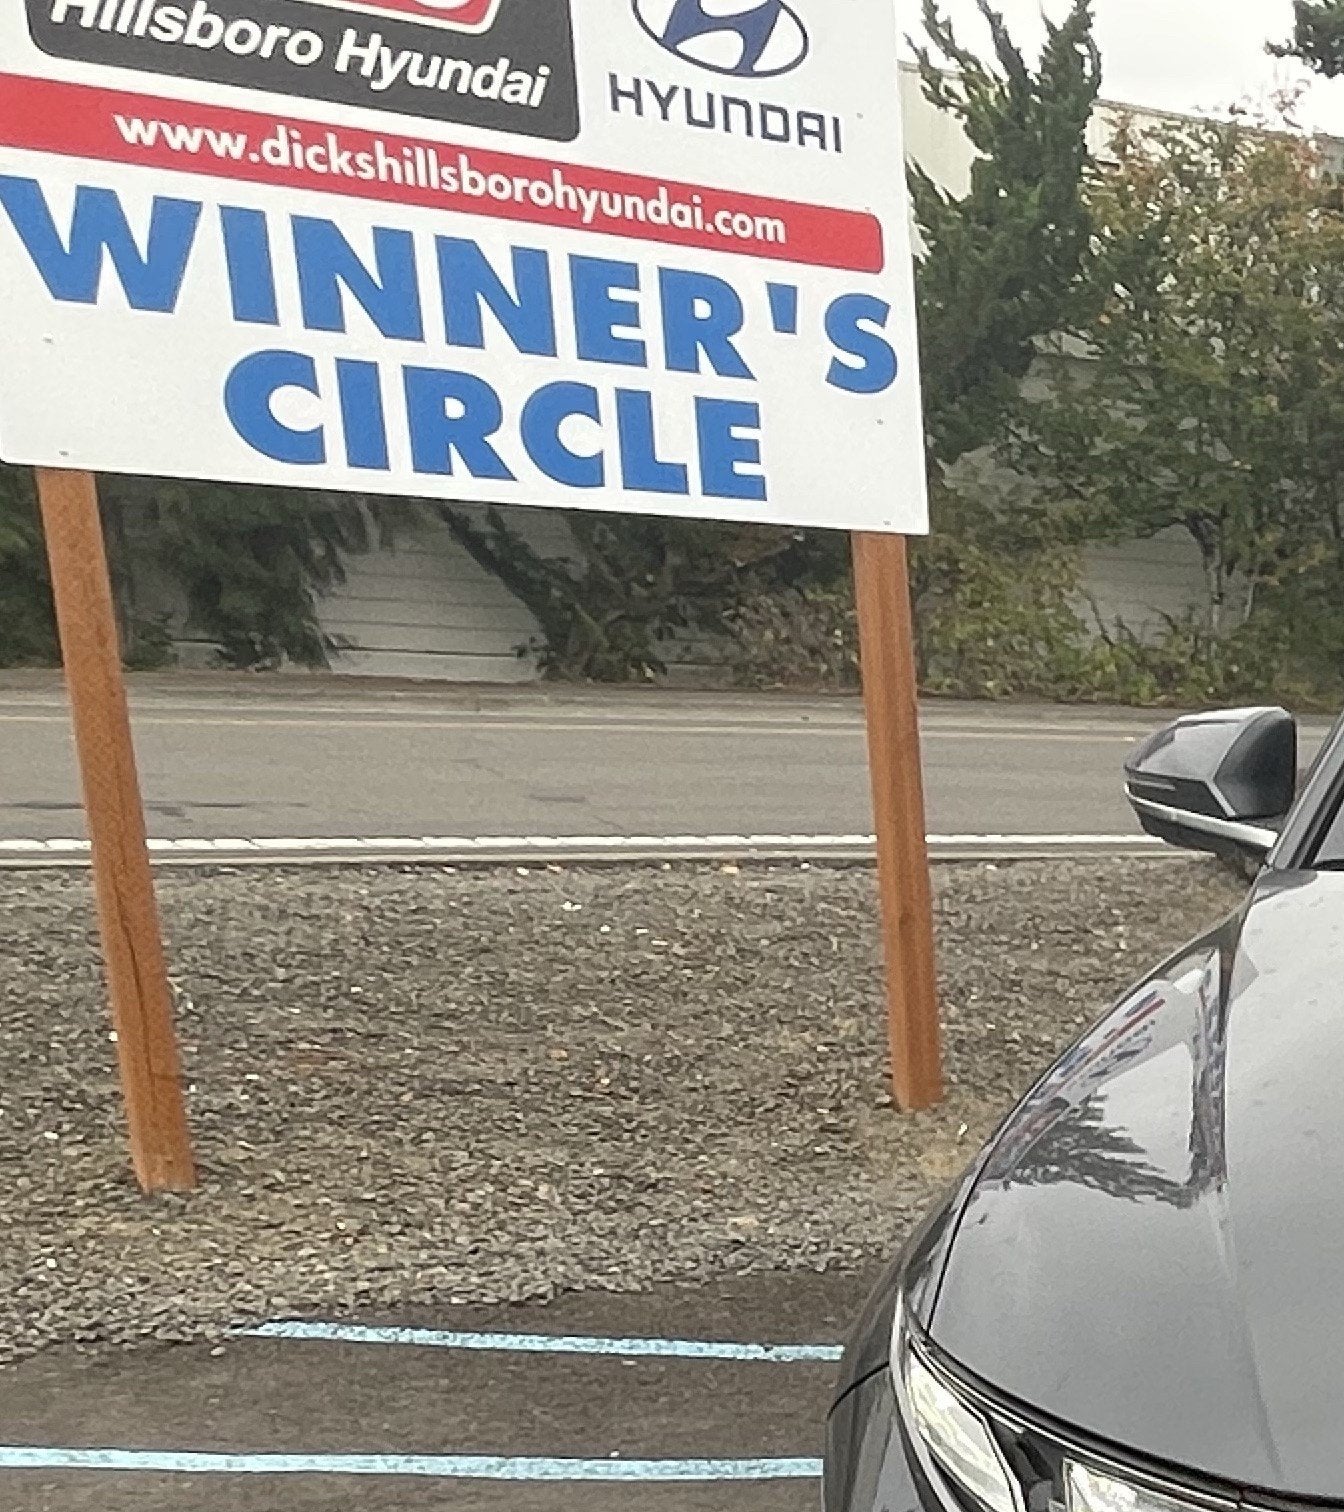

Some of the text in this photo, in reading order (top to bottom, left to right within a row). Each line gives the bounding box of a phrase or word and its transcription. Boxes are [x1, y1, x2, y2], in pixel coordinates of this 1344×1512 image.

[50, 0, 550, 108] Hillsboro Hyundai
[609, 74, 842, 153] HYUNDAI
[114, 113, 787, 244] www.dickshillsborohyundai.com
[1, 176, 898, 394] WINNER'S
[223, 350, 768, 502] CIRCLE
